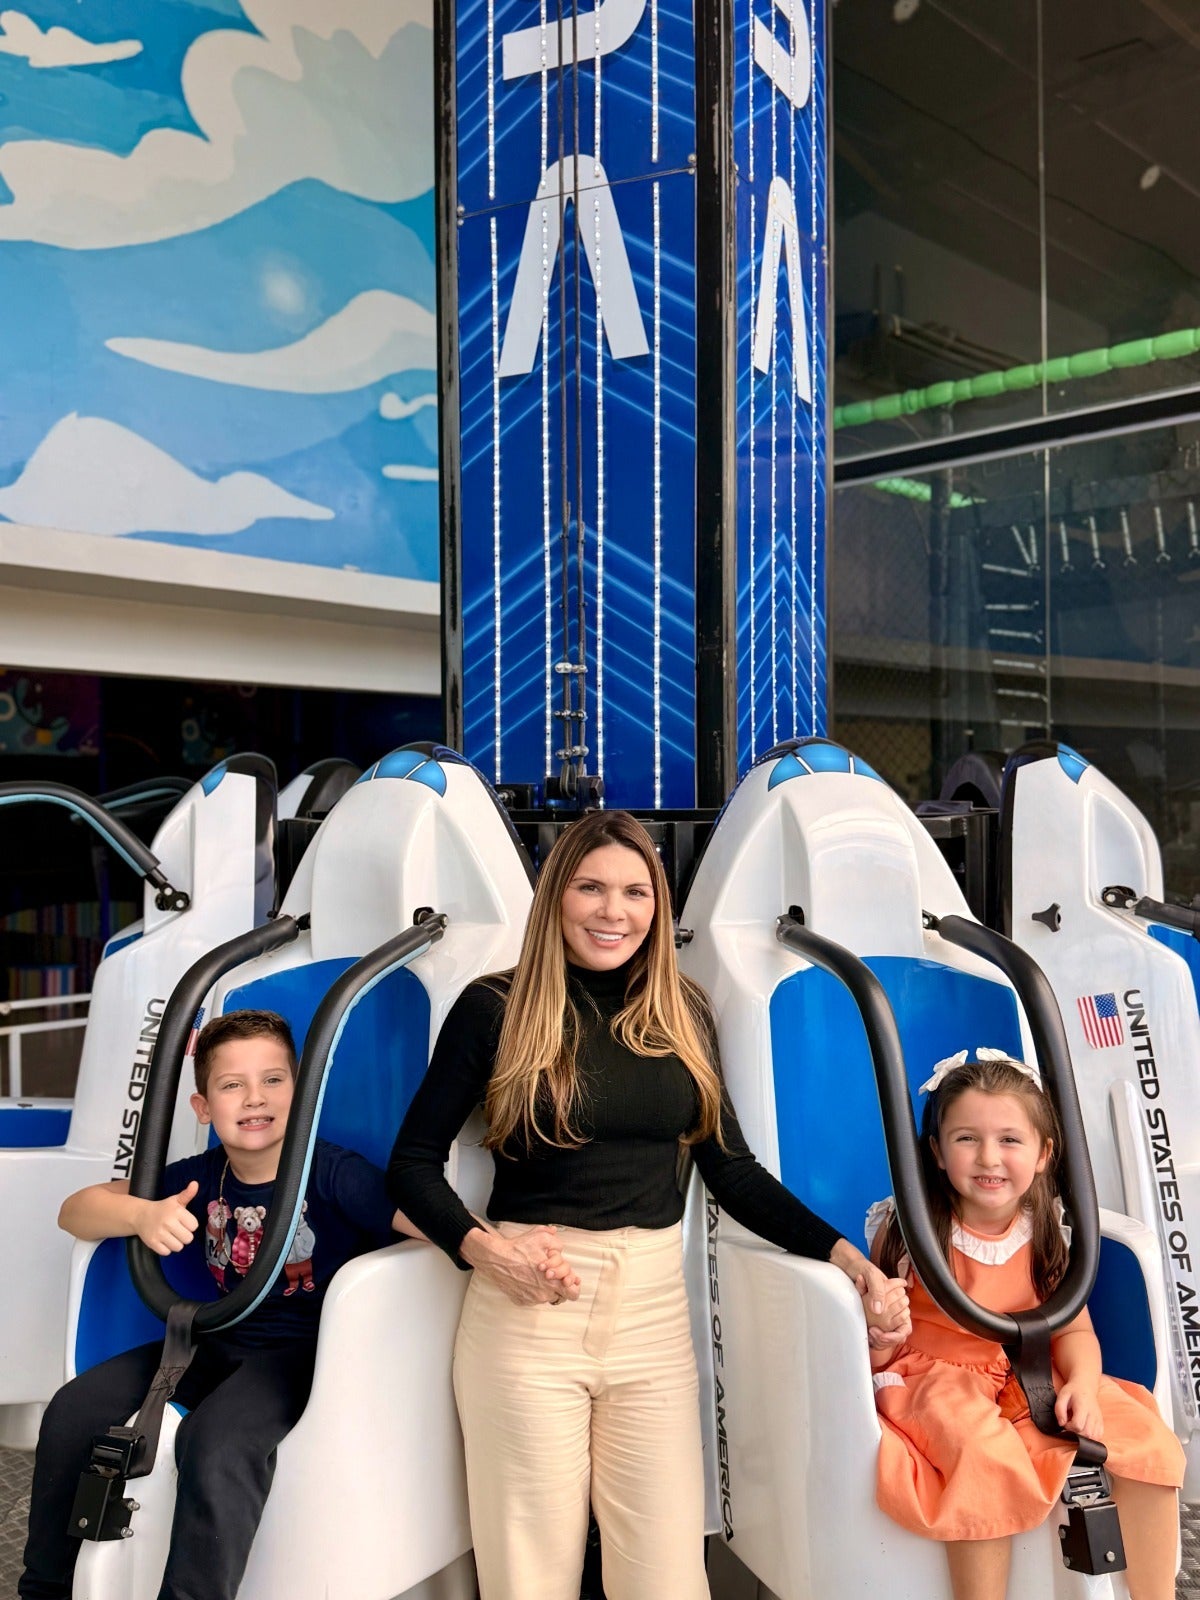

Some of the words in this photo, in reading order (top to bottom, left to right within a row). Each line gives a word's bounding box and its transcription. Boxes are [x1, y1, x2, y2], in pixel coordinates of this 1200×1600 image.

[128, 998, 165, 1101] UNITED
[111, 1108, 140, 1182] STAT
[1123, 989, 1160, 1100] UNITED
[1146, 1108, 1184, 1222] STATES
[1168, 1230, 1193, 1273] OF
[707, 1198, 720, 1306] TATES
[713, 1314, 724, 1368] OF
[716, 1375, 734, 1542] AMERICA
